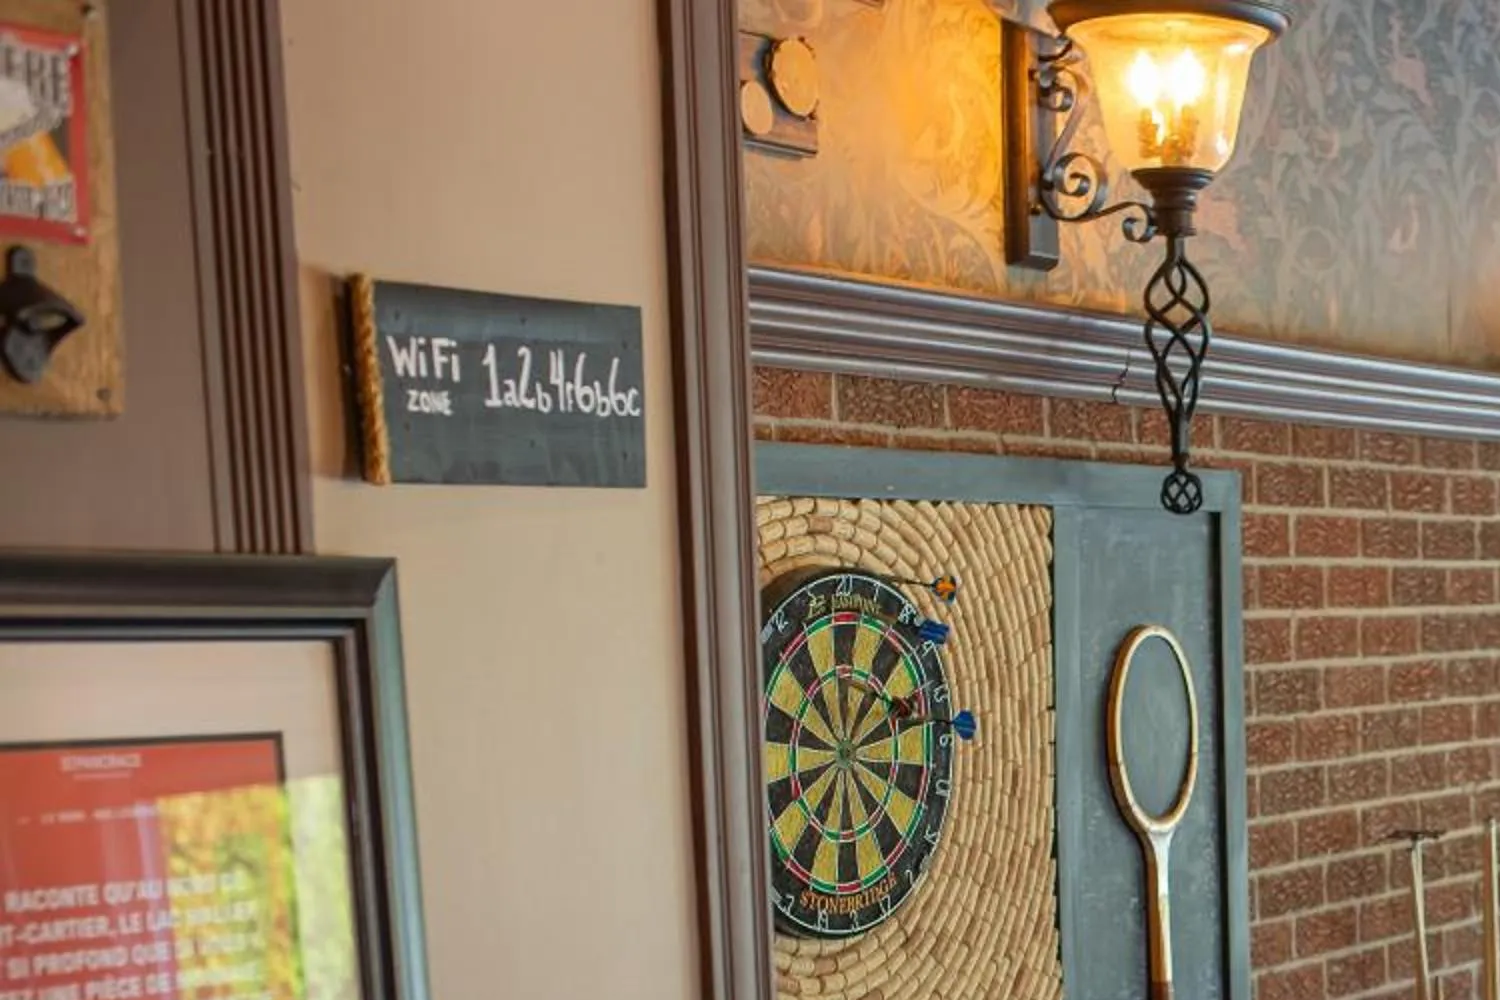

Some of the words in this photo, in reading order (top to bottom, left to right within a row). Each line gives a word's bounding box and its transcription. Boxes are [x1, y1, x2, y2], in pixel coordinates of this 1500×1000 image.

[386, 335, 461, 383] WiFi
[406, 389, 454, 416] ZONE
[5, 884, 99, 911] RACONTE
[117, 911, 142, 934] LE
[33, 946, 128, 976] PROFOND
